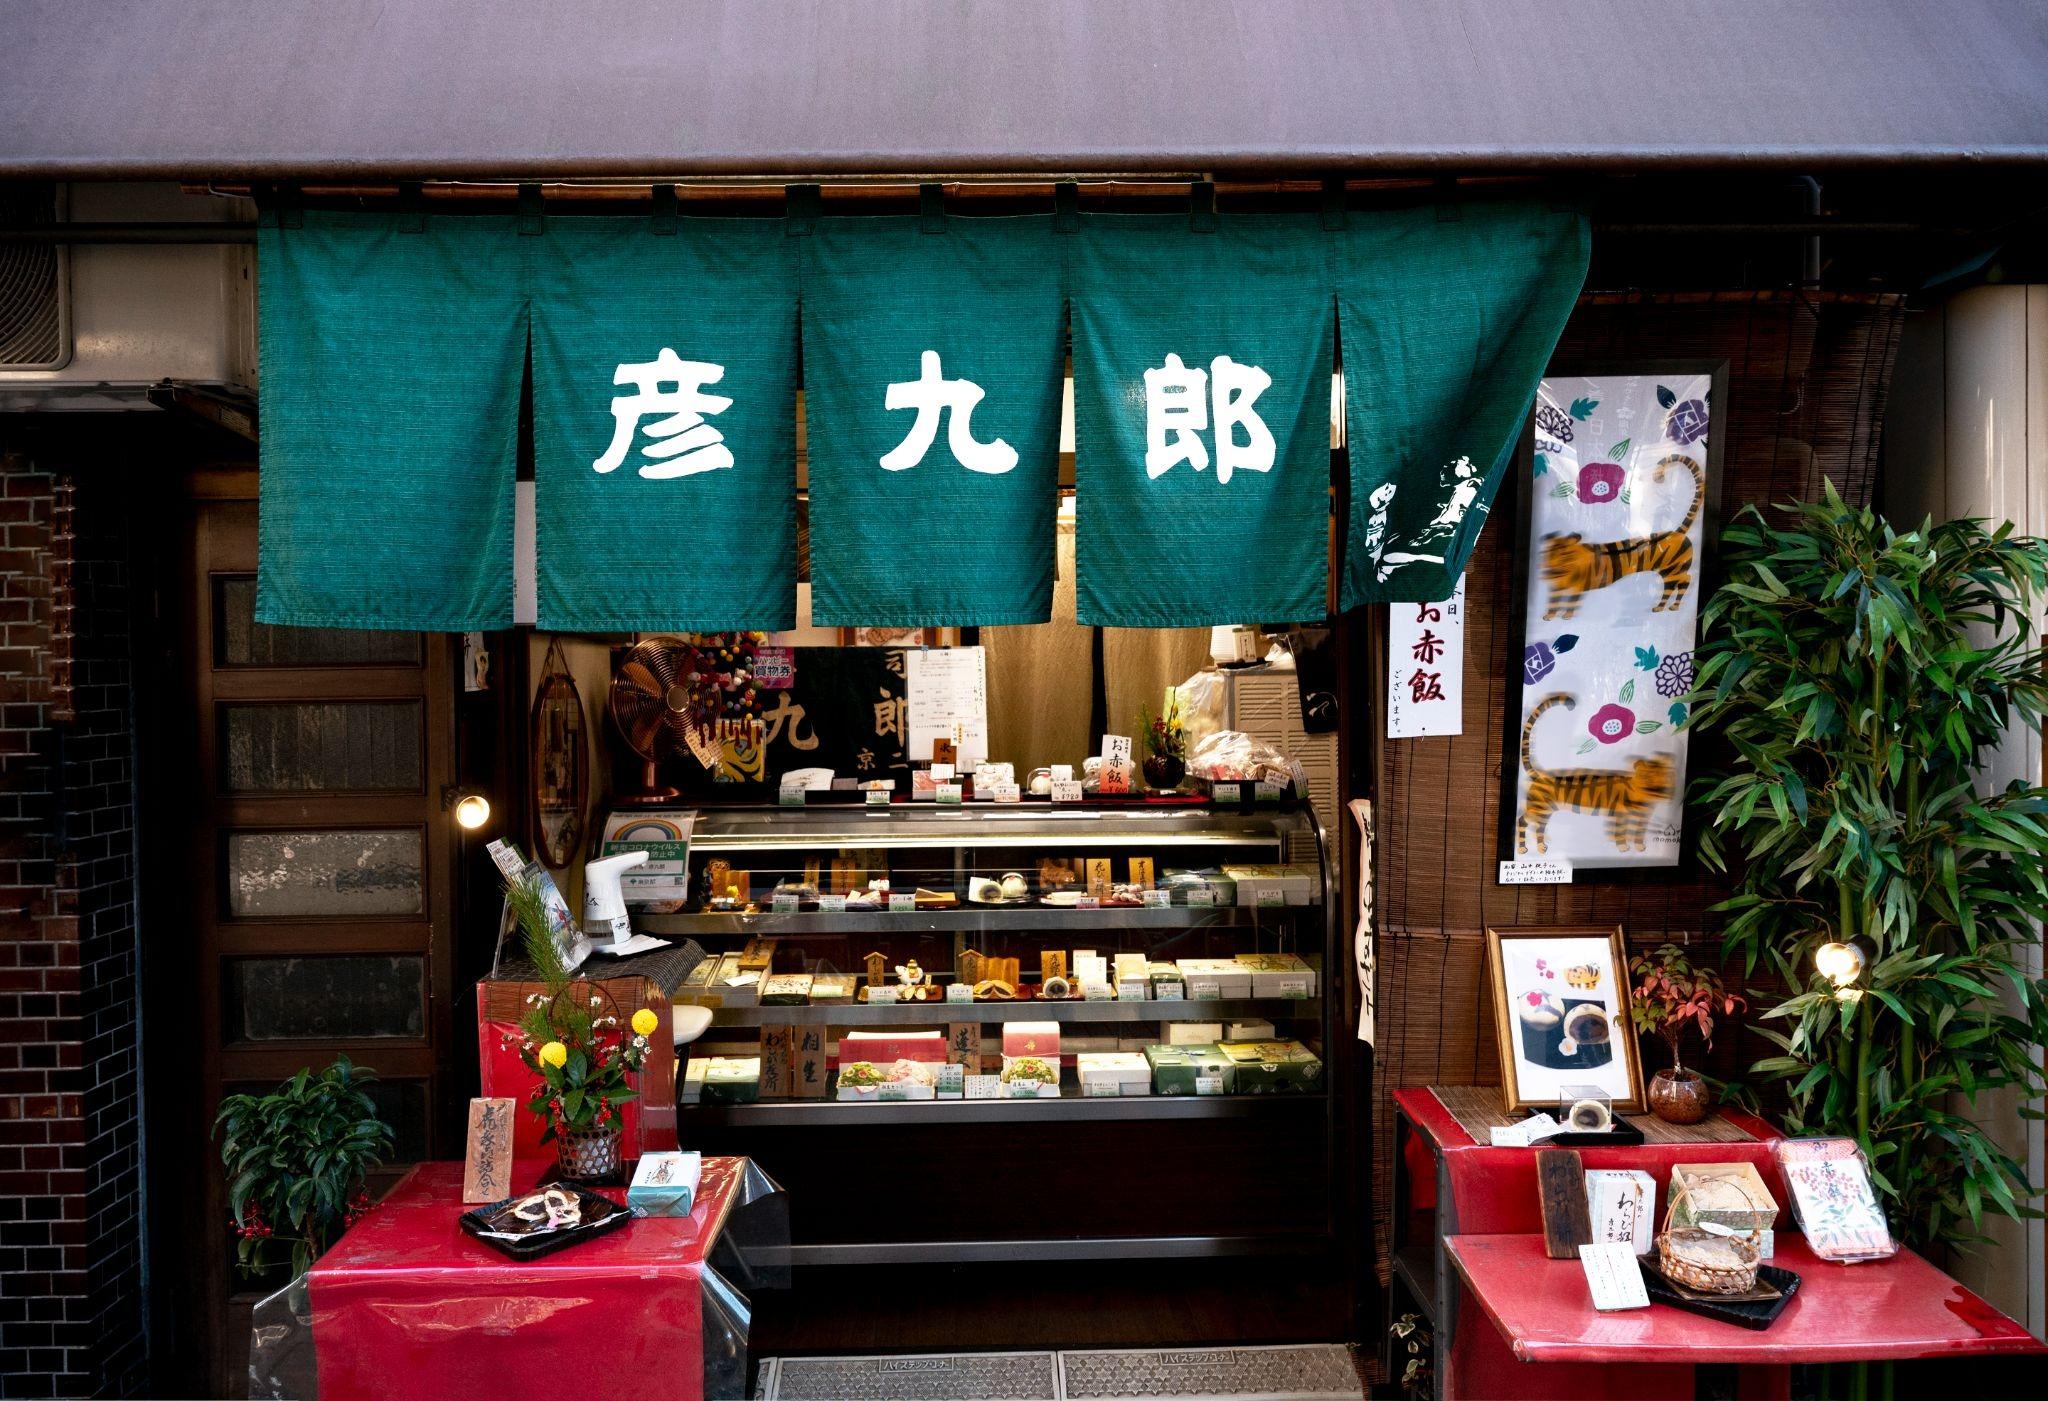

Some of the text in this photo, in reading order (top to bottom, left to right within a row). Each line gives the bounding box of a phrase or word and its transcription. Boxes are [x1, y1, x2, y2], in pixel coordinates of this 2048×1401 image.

[593, 347, 1277, 485] 彦九郎
[754, 664, 792, 678] 買物券
[1408, 602, 1446, 704] お赤飯
[1106, 738, 1123, 785] お赤飯
[610, 843, 681, 852] 新型コロナウイルス
